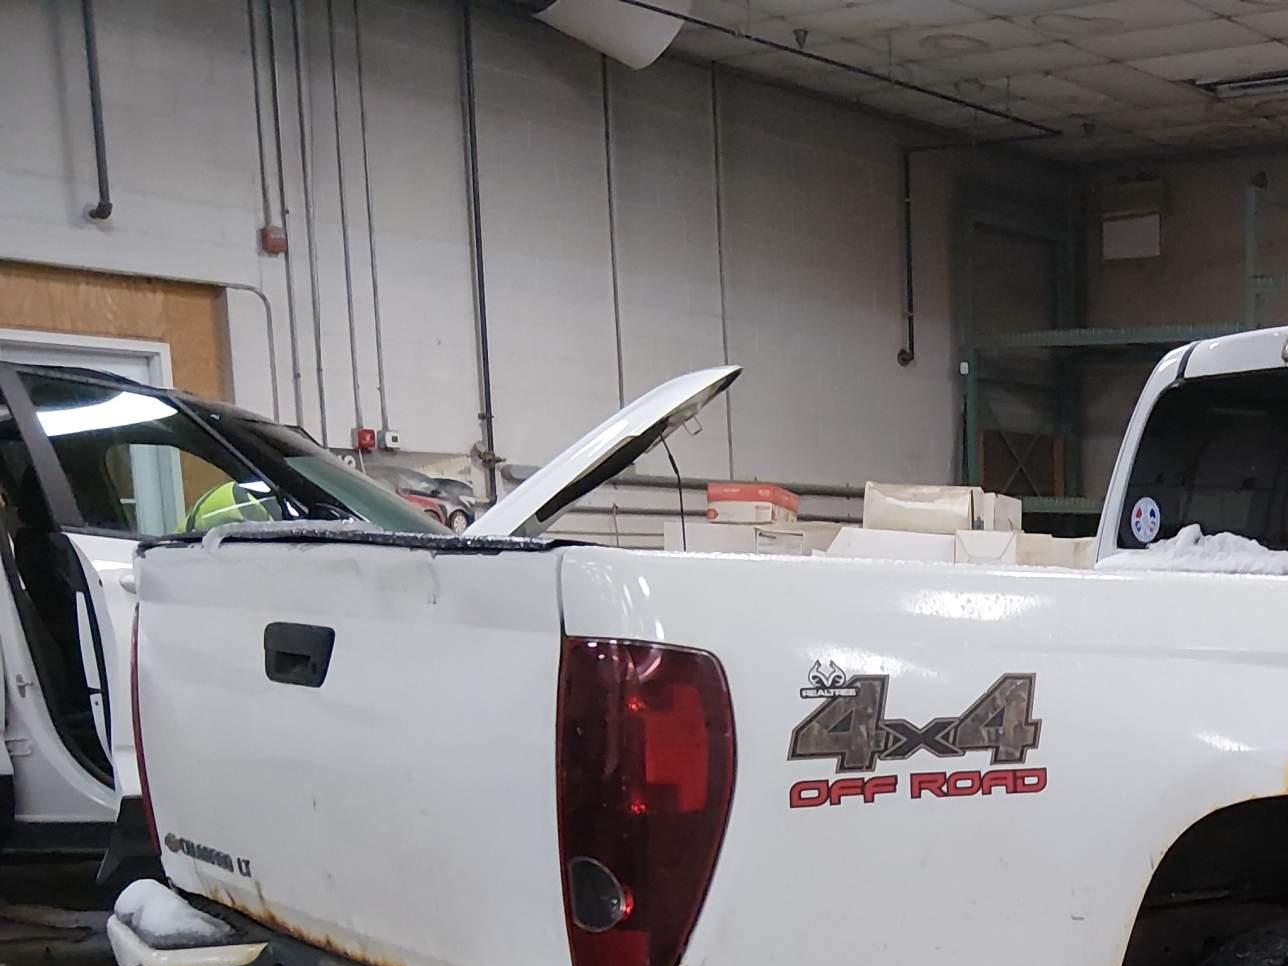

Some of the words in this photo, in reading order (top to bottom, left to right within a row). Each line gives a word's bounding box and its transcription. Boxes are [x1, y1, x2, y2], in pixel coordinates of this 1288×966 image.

[801, 687, 857, 698] REALTREE
[789, 775, 899, 808] OFF
[910, 767, 1047, 799] ROAD
[237, 857, 252, 878] LT
